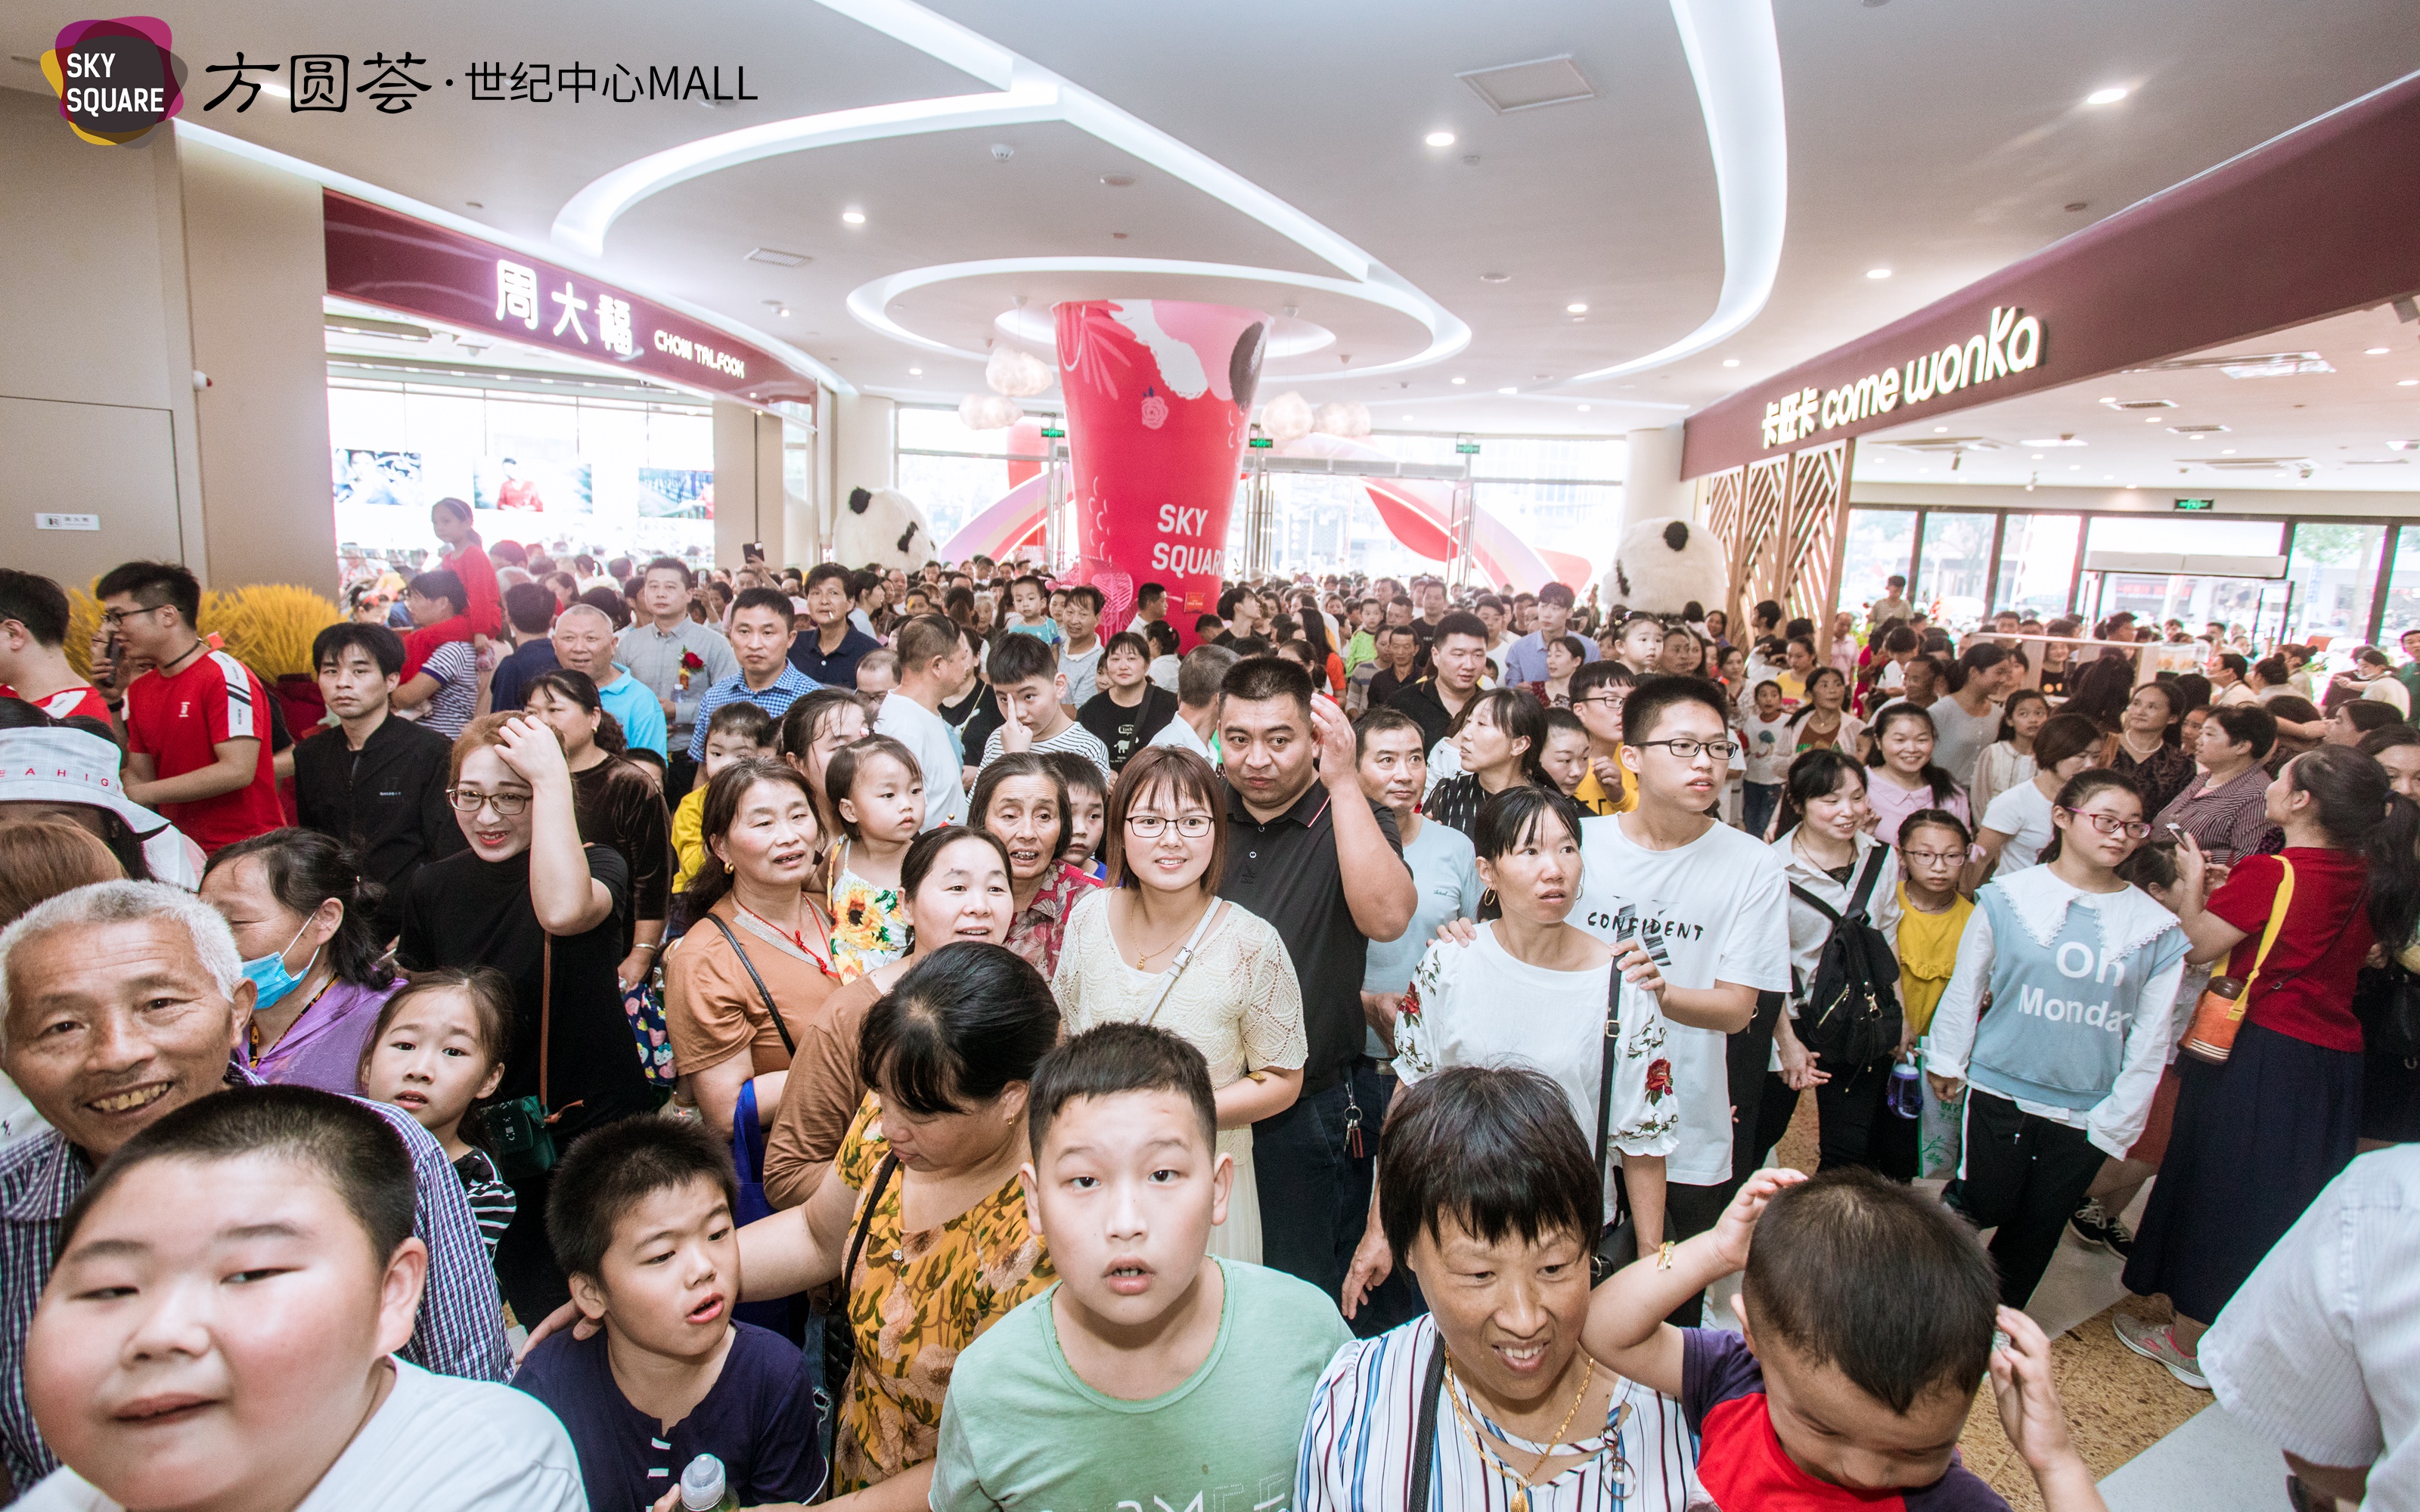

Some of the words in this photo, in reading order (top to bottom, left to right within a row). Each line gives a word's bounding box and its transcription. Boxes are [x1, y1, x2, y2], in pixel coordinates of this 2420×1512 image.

[495, 259, 633, 355] 周大福
[654, 330, 693, 361] CHOW
[1761, 386, 1820, 450] 卡旺卡
[1821, 367, 1900, 429] come
[1157, 503, 1208, 537] SKY
[1587, 911, 1704, 942] CONFIDENT
[2055, 940, 2126, 987] Oh
